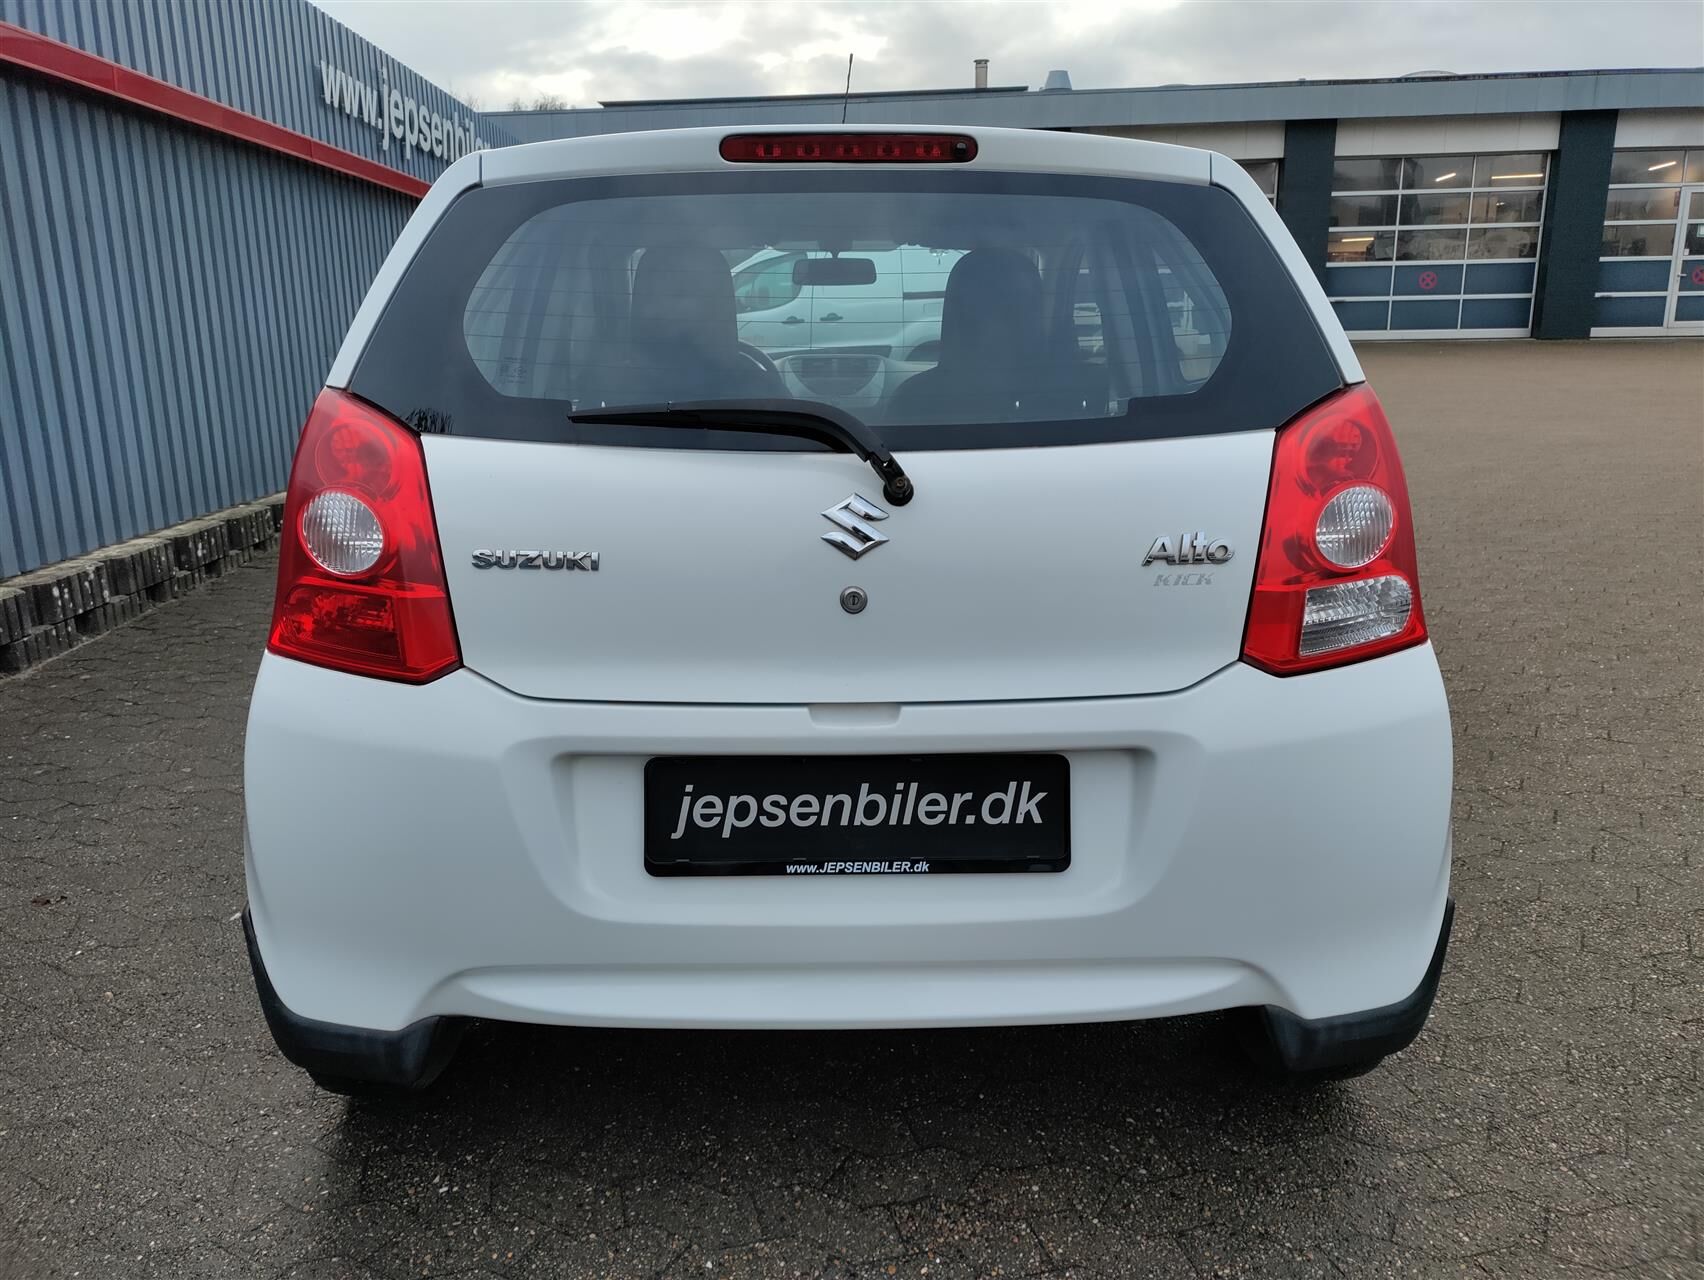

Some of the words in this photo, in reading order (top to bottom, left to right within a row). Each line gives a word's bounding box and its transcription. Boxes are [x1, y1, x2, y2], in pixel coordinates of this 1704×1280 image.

[320, 60, 490, 163] www.jepsenbil
[471, 549, 600, 571] SUZUKI
[1141, 531, 1235, 567] Alto
[670, 781, 1048, 839] jepsenbiler.dk
[786, 861, 930, 874] www.JEPSENBILER.dk
